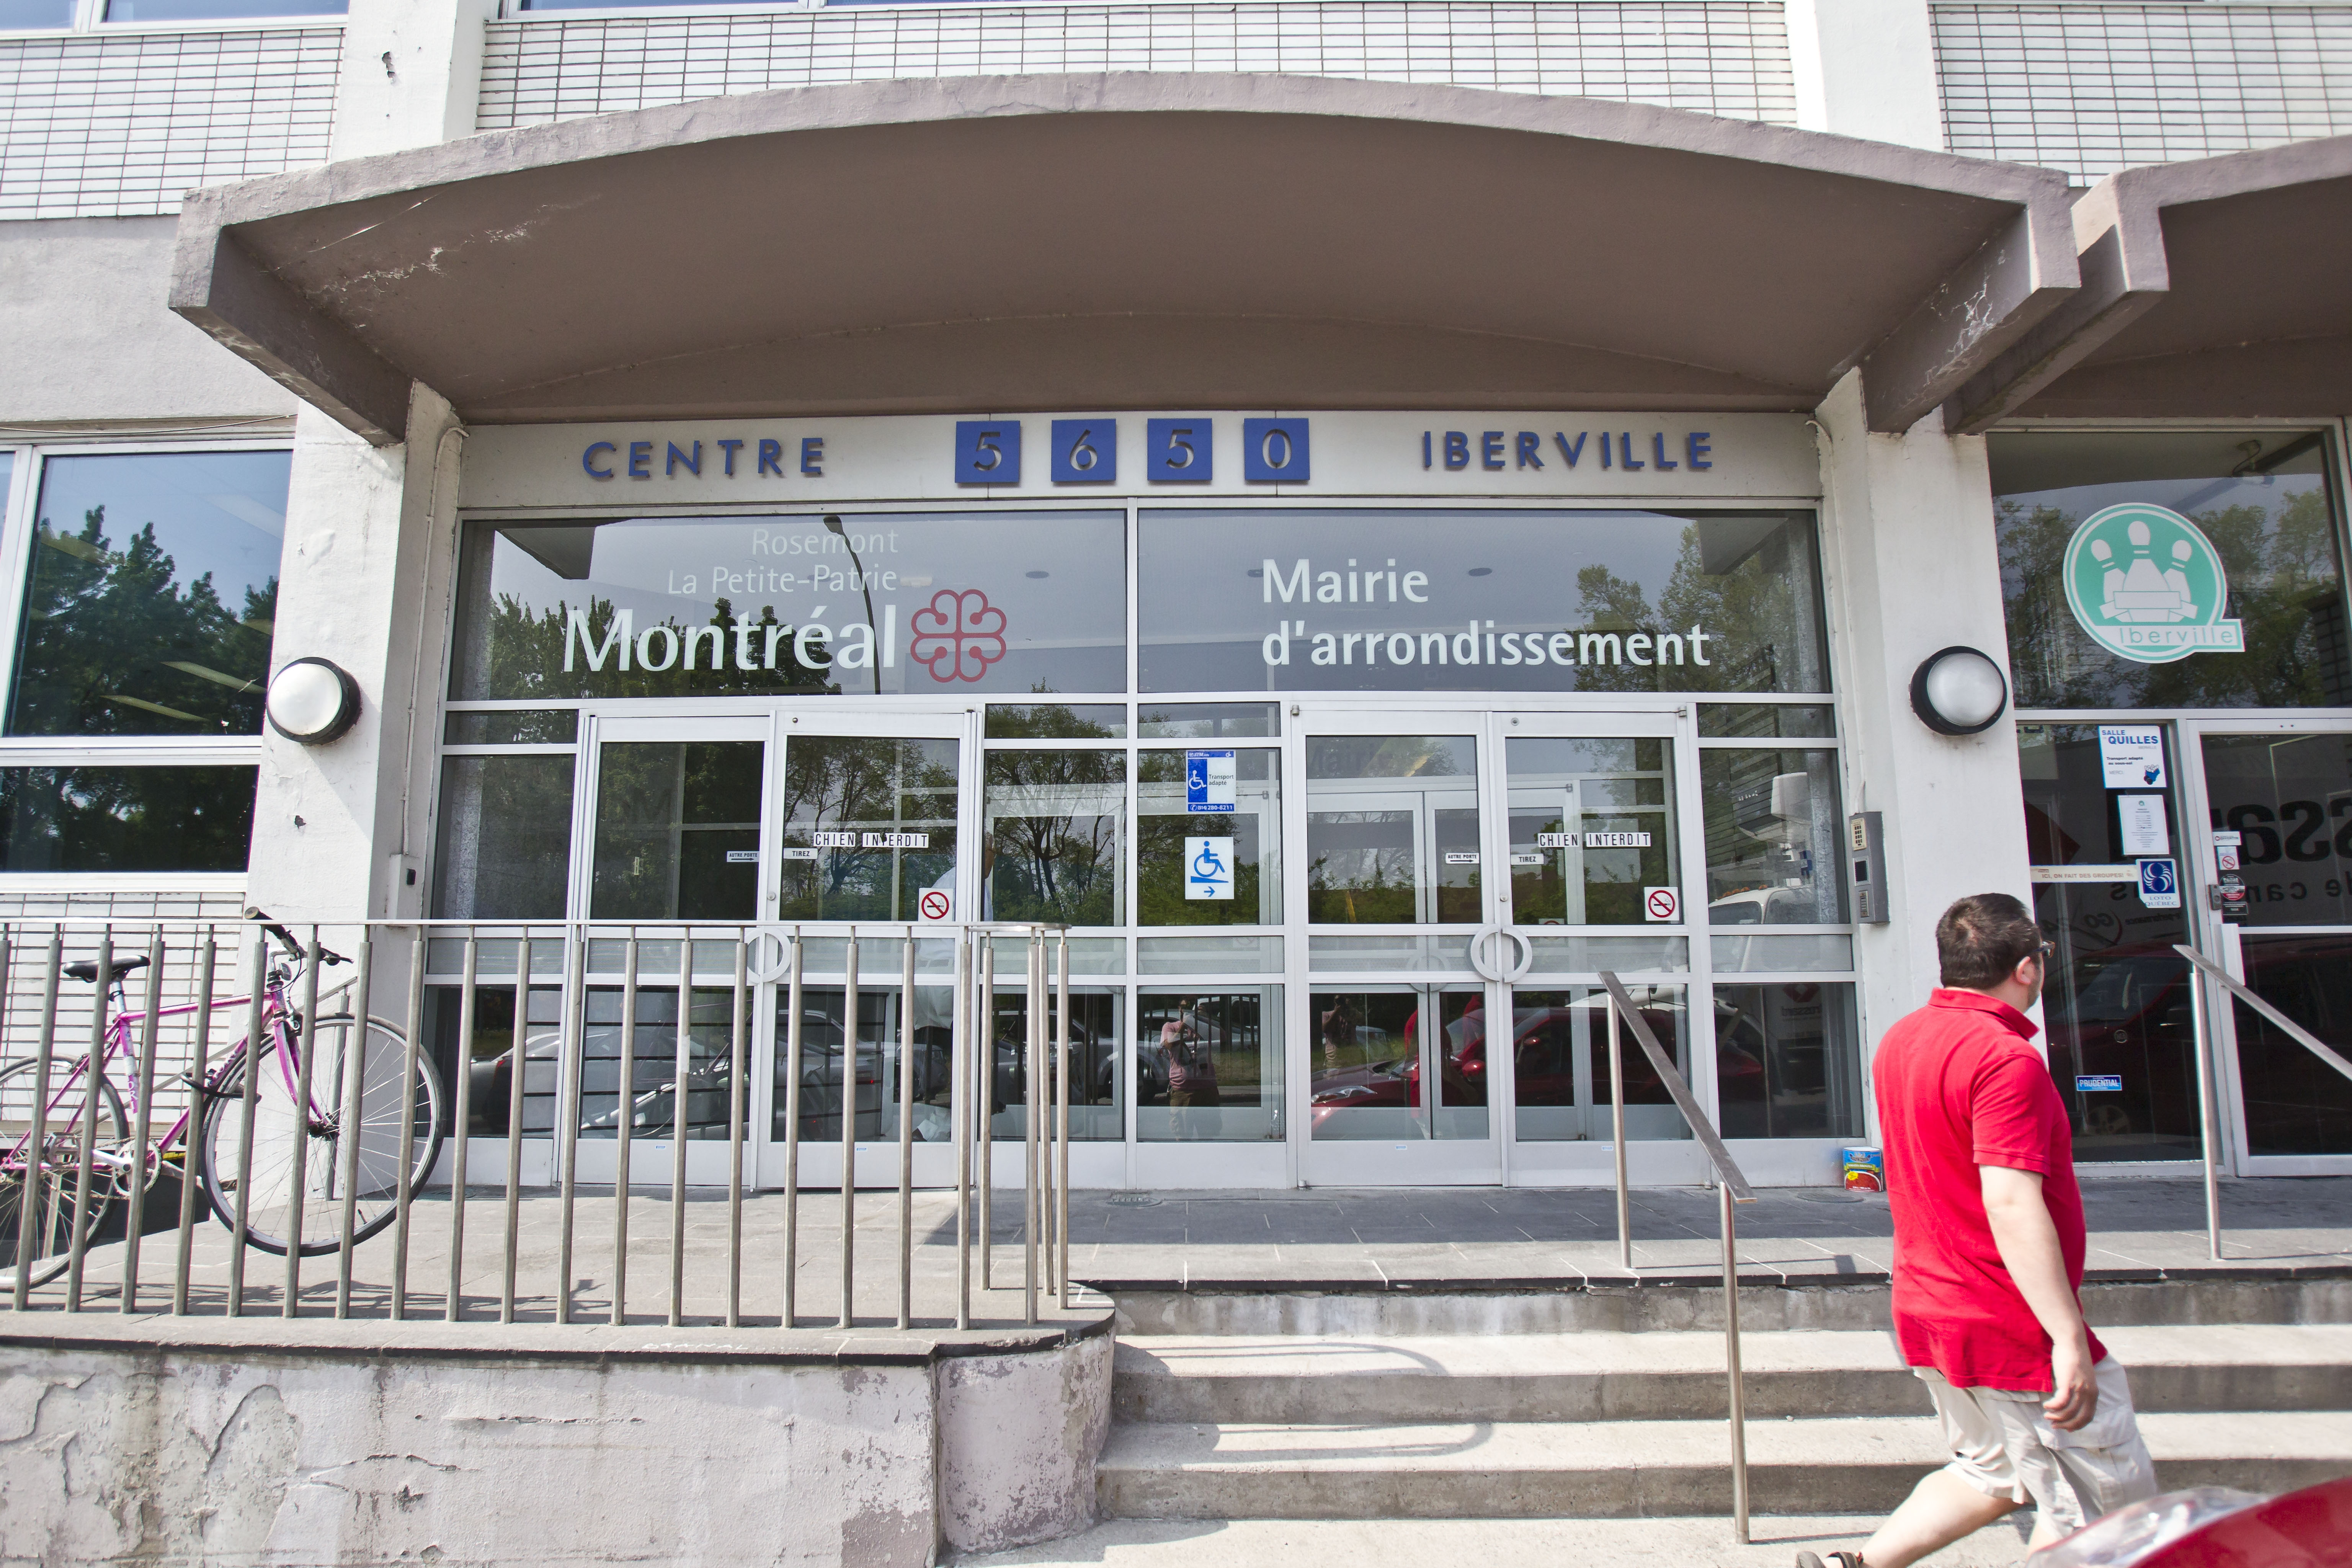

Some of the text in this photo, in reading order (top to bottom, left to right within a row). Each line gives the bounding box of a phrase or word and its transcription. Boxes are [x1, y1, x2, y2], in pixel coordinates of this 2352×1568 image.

[583, 437, 823, 477] CENTRE
[1422, 431, 1713, 469] IBERVILLE
[752, 529, 899, 555] Rosemont
[668, 563, 897, 595] La Petite-Patrie
[1263, 558, 1429, 603] Mairie
[563, 604, 896, 673] Montréal
[1262, 620, 1711, 666] d'arrondissement
[2120, 627, 2233, 644] Iberville
[2108, 736, 2159, 744] QUILLES
[815, 833, 854, 846] CHIEN
[1539, 833, 1650, 846] CHIEN INTERDIT
